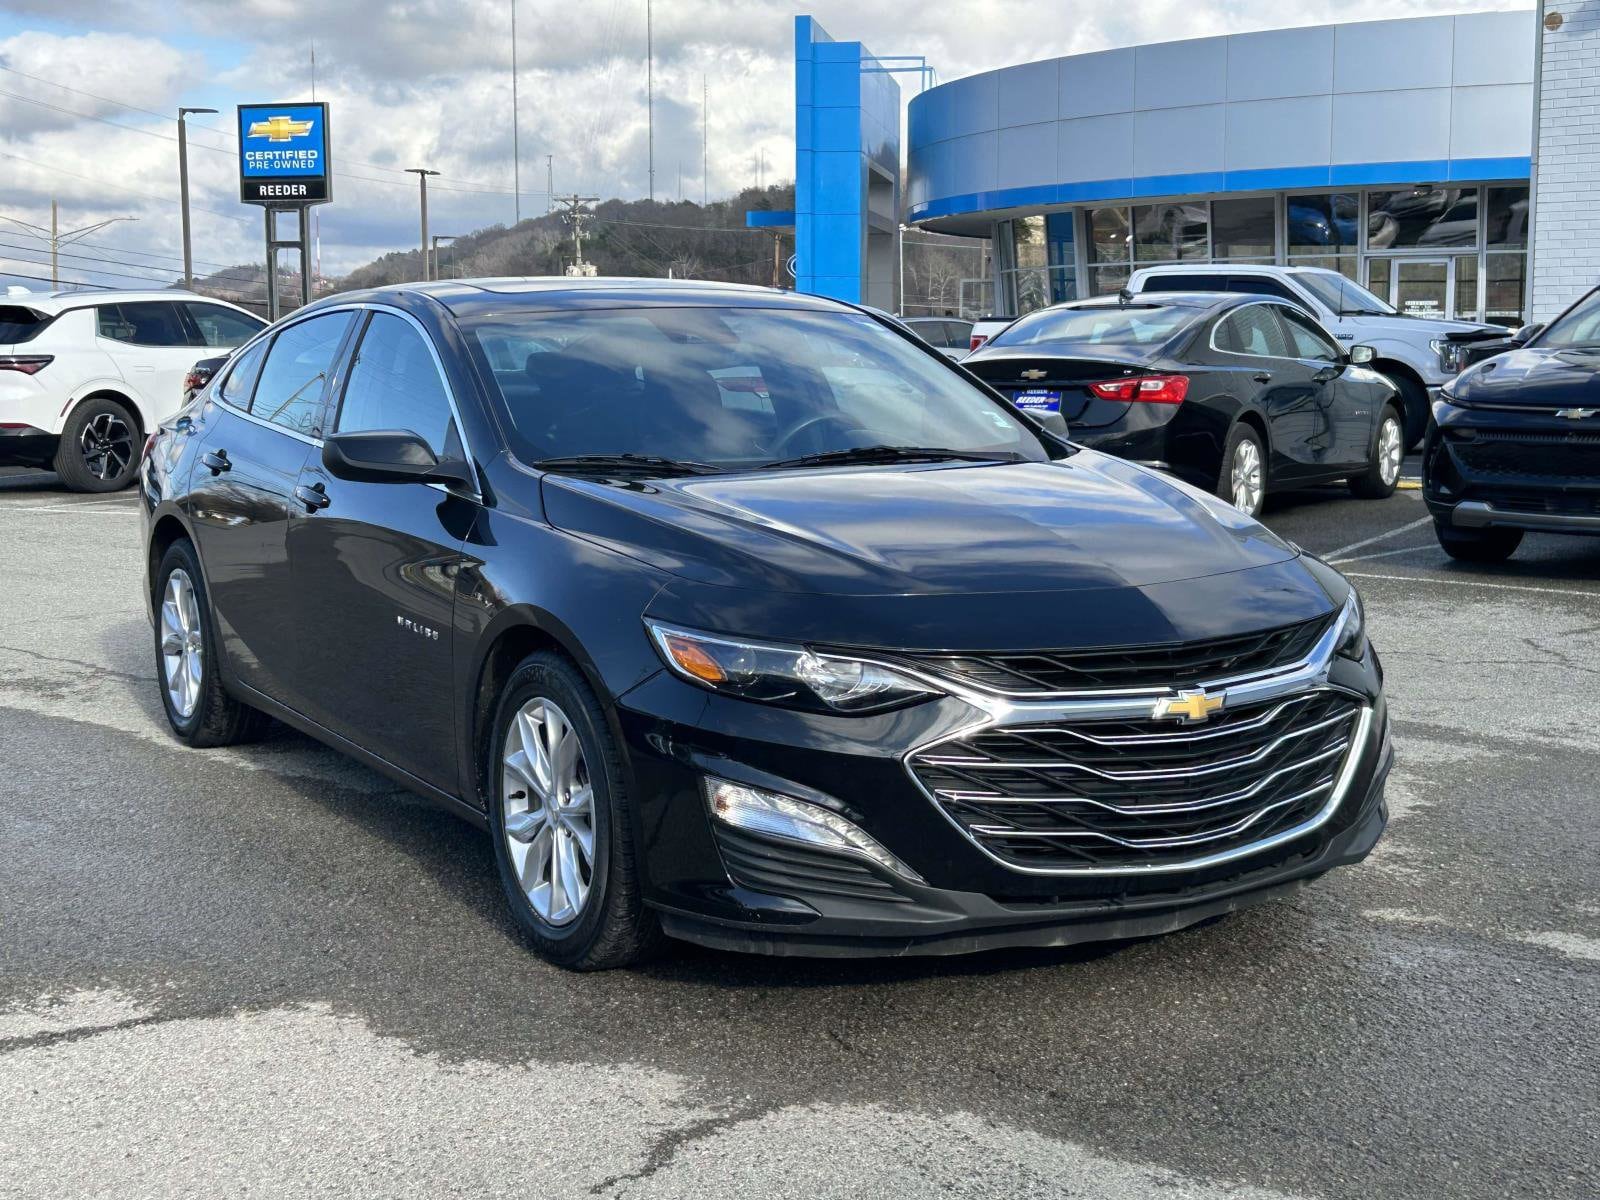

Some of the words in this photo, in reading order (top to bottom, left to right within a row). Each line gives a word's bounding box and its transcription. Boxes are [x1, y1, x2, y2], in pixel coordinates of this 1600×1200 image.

[245, 150, 318, 160] CERTIFIED
[249, 160, 315, 169] PRE-OWNED
[259, 185, 307, 196] REEDER
